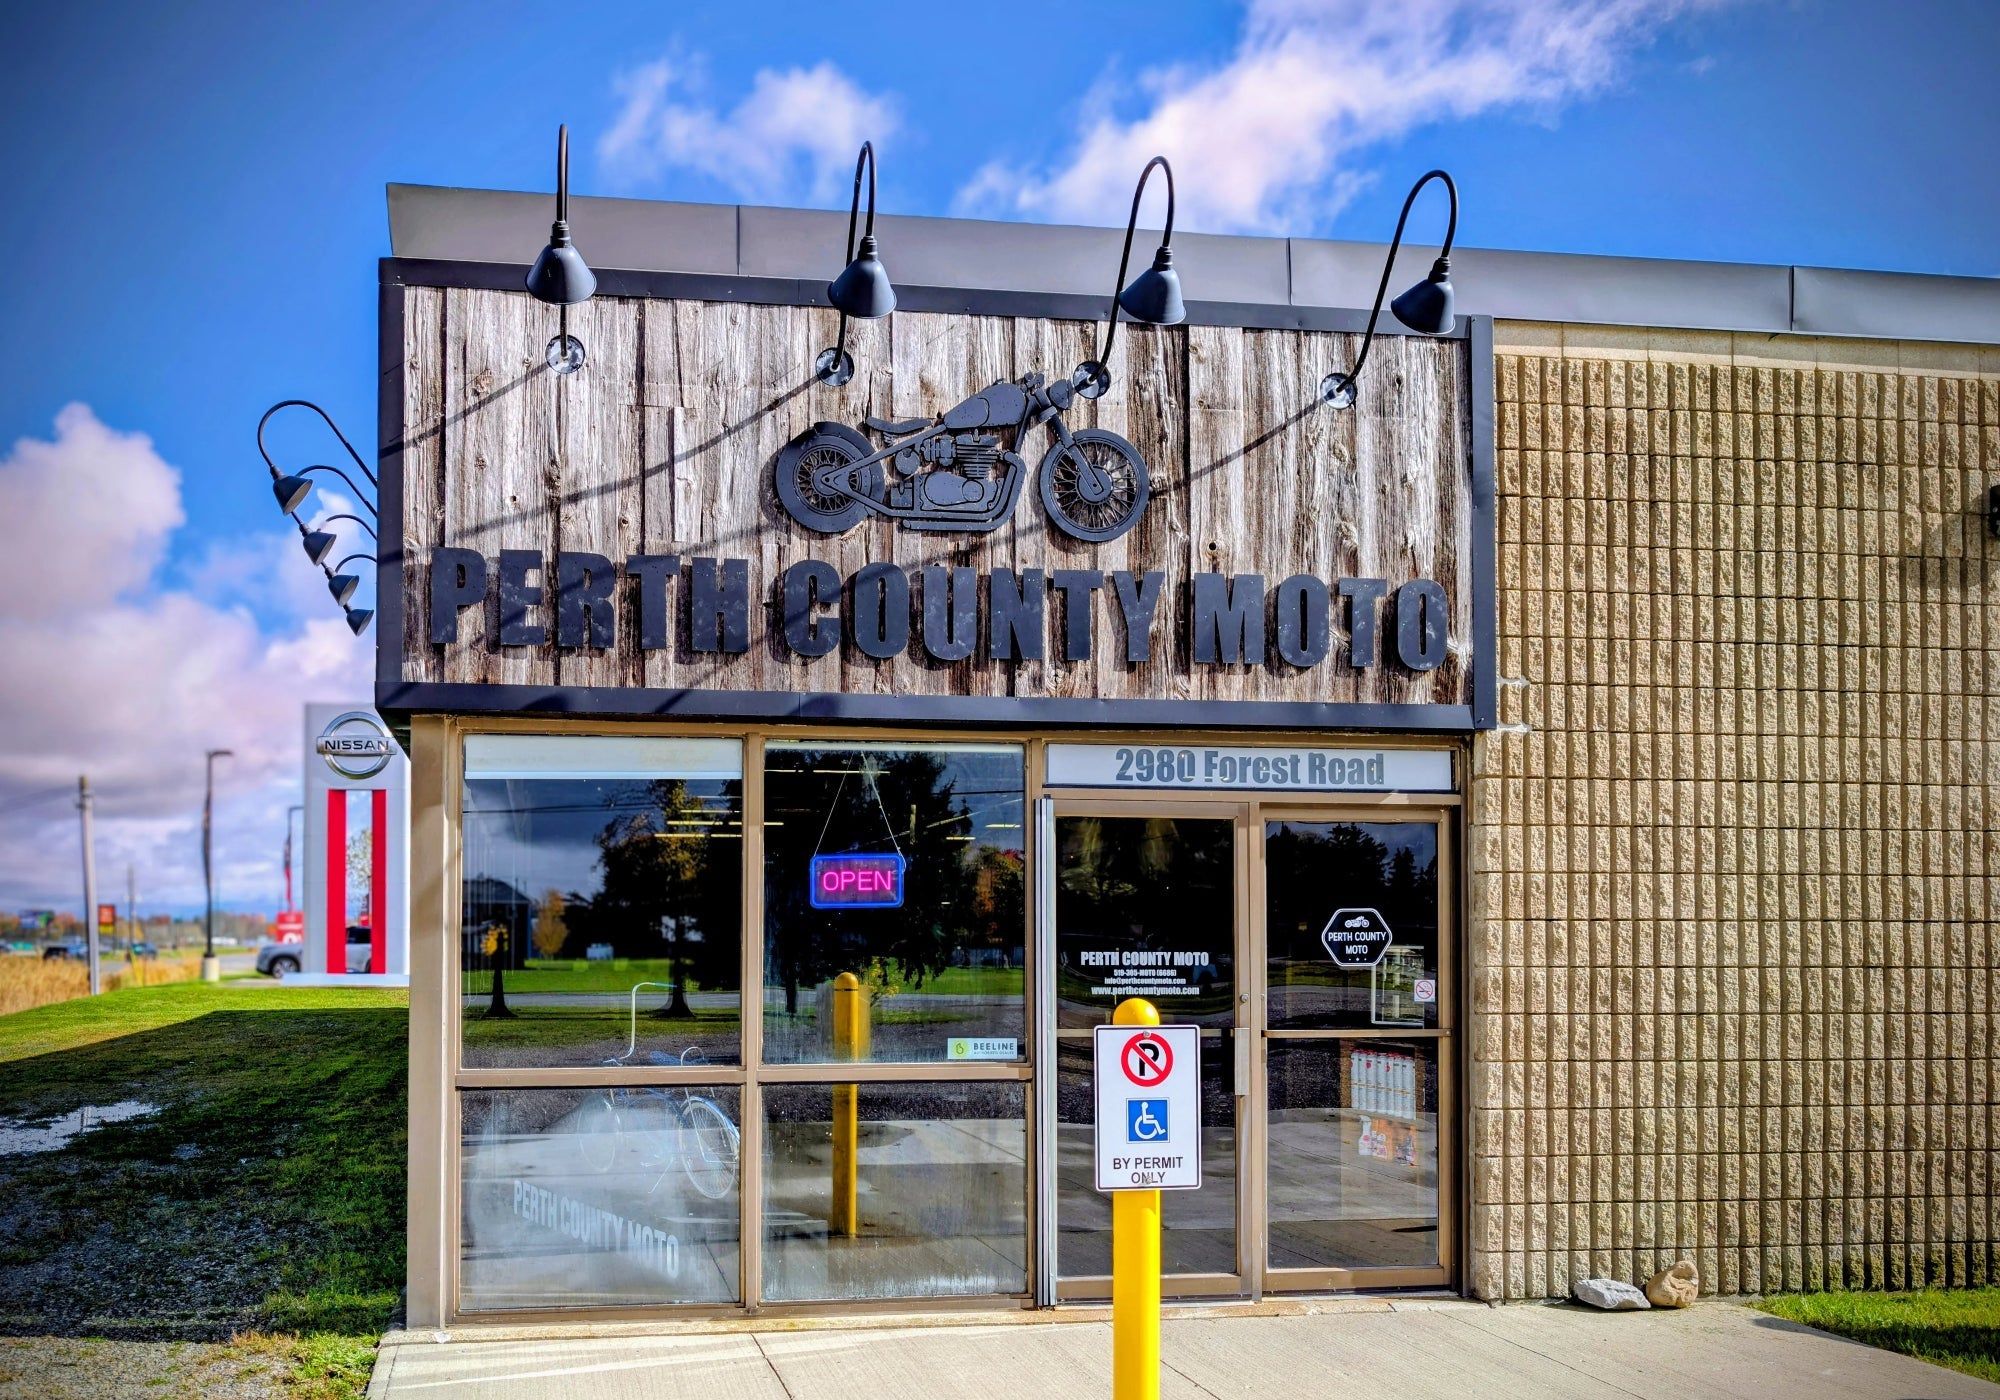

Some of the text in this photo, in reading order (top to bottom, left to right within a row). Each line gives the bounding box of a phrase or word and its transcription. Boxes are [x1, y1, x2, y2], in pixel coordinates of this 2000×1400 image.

[431, 546, 1448, 671] PERTH COUNTY MOTO
[324, 740, 389, 750] NISSAN
[1115, 748, 1384, 785] 2980 Forest Road
[822, 870, 892, 891] OPEN
[1328, 931, 1387, 942] PERTH COUNTY
[1345, 944, 1368, 955] MOTO
[1080, 951, 1210, 966] PERTH COUNTY MOTO
[1104, 977, 1186, 985] info@perthcountymoto.com
[1091, 986, 1200, 996] www.perthcountymoto.com
[973, 1042, 1014, 1051] BEELINE
[1113, 1156, 1183, 1170] BY PERMIT
[1131, 1171, 1166, 1184] ONLY
[513, 1180, 680, 1280] PERTH COUNTY MOTO
